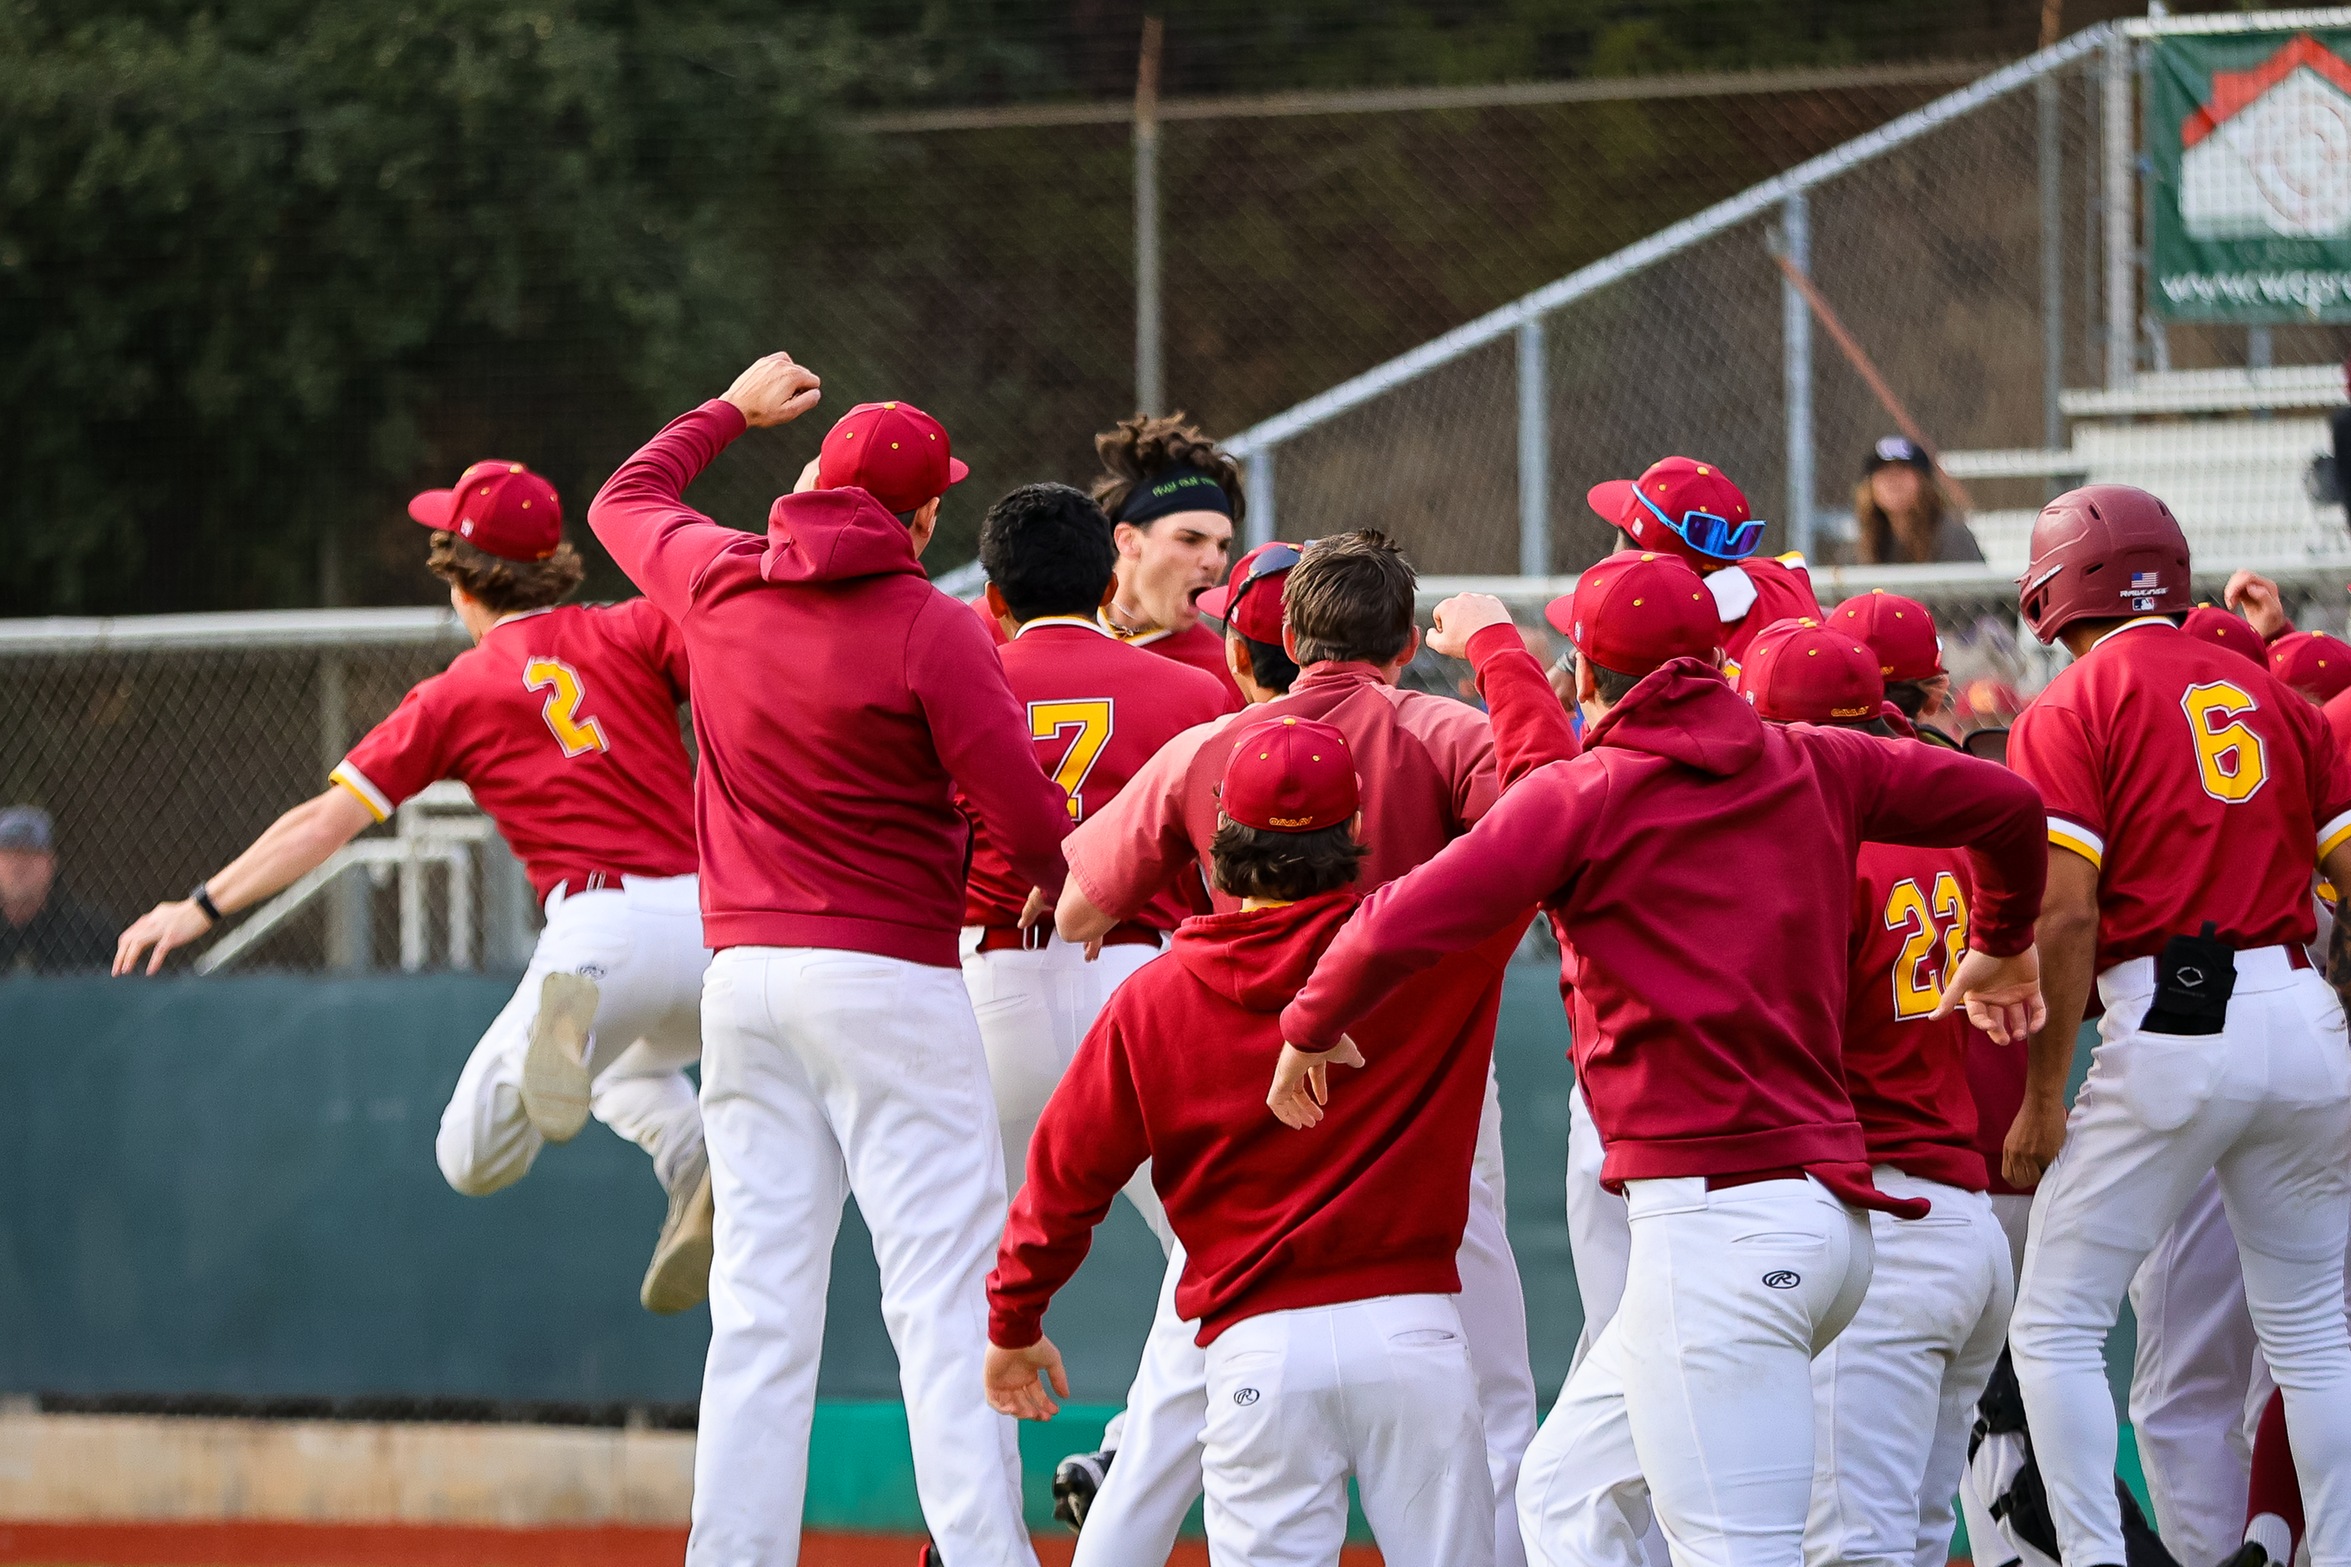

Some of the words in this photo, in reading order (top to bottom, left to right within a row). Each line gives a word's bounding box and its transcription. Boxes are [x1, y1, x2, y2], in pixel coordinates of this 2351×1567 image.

[522, 655, 610, 758] 2
[1027, 697, 1114, 821] 7
[2180, 679, 2269, 804] 6
[1884, 871, 1969, 1022] 22
